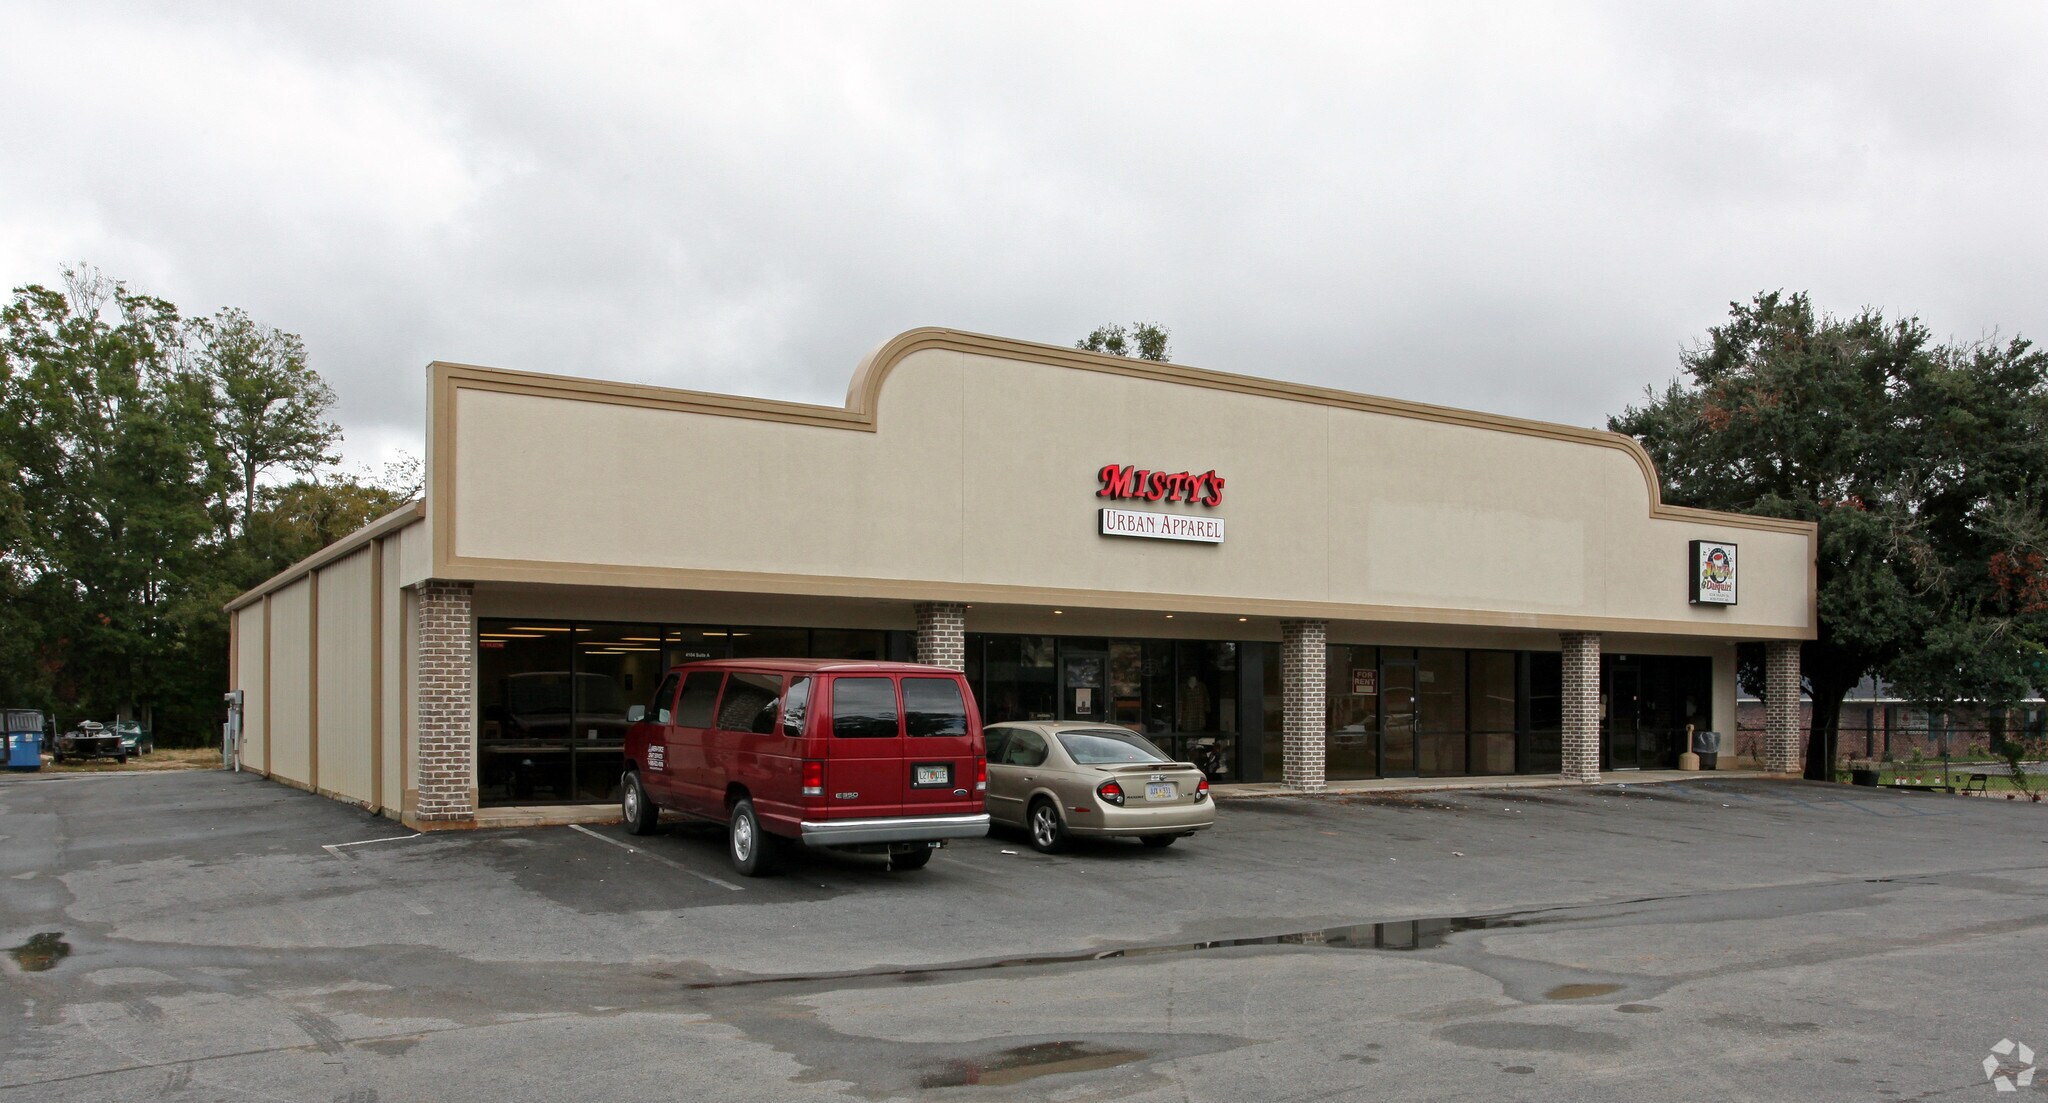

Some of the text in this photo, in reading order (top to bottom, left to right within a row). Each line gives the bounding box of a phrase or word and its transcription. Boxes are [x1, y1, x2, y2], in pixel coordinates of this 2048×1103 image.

[1096, 464, 1225, 507] MISTY'S
[1106, 511, 1221, 538] URBAN APPAREL
